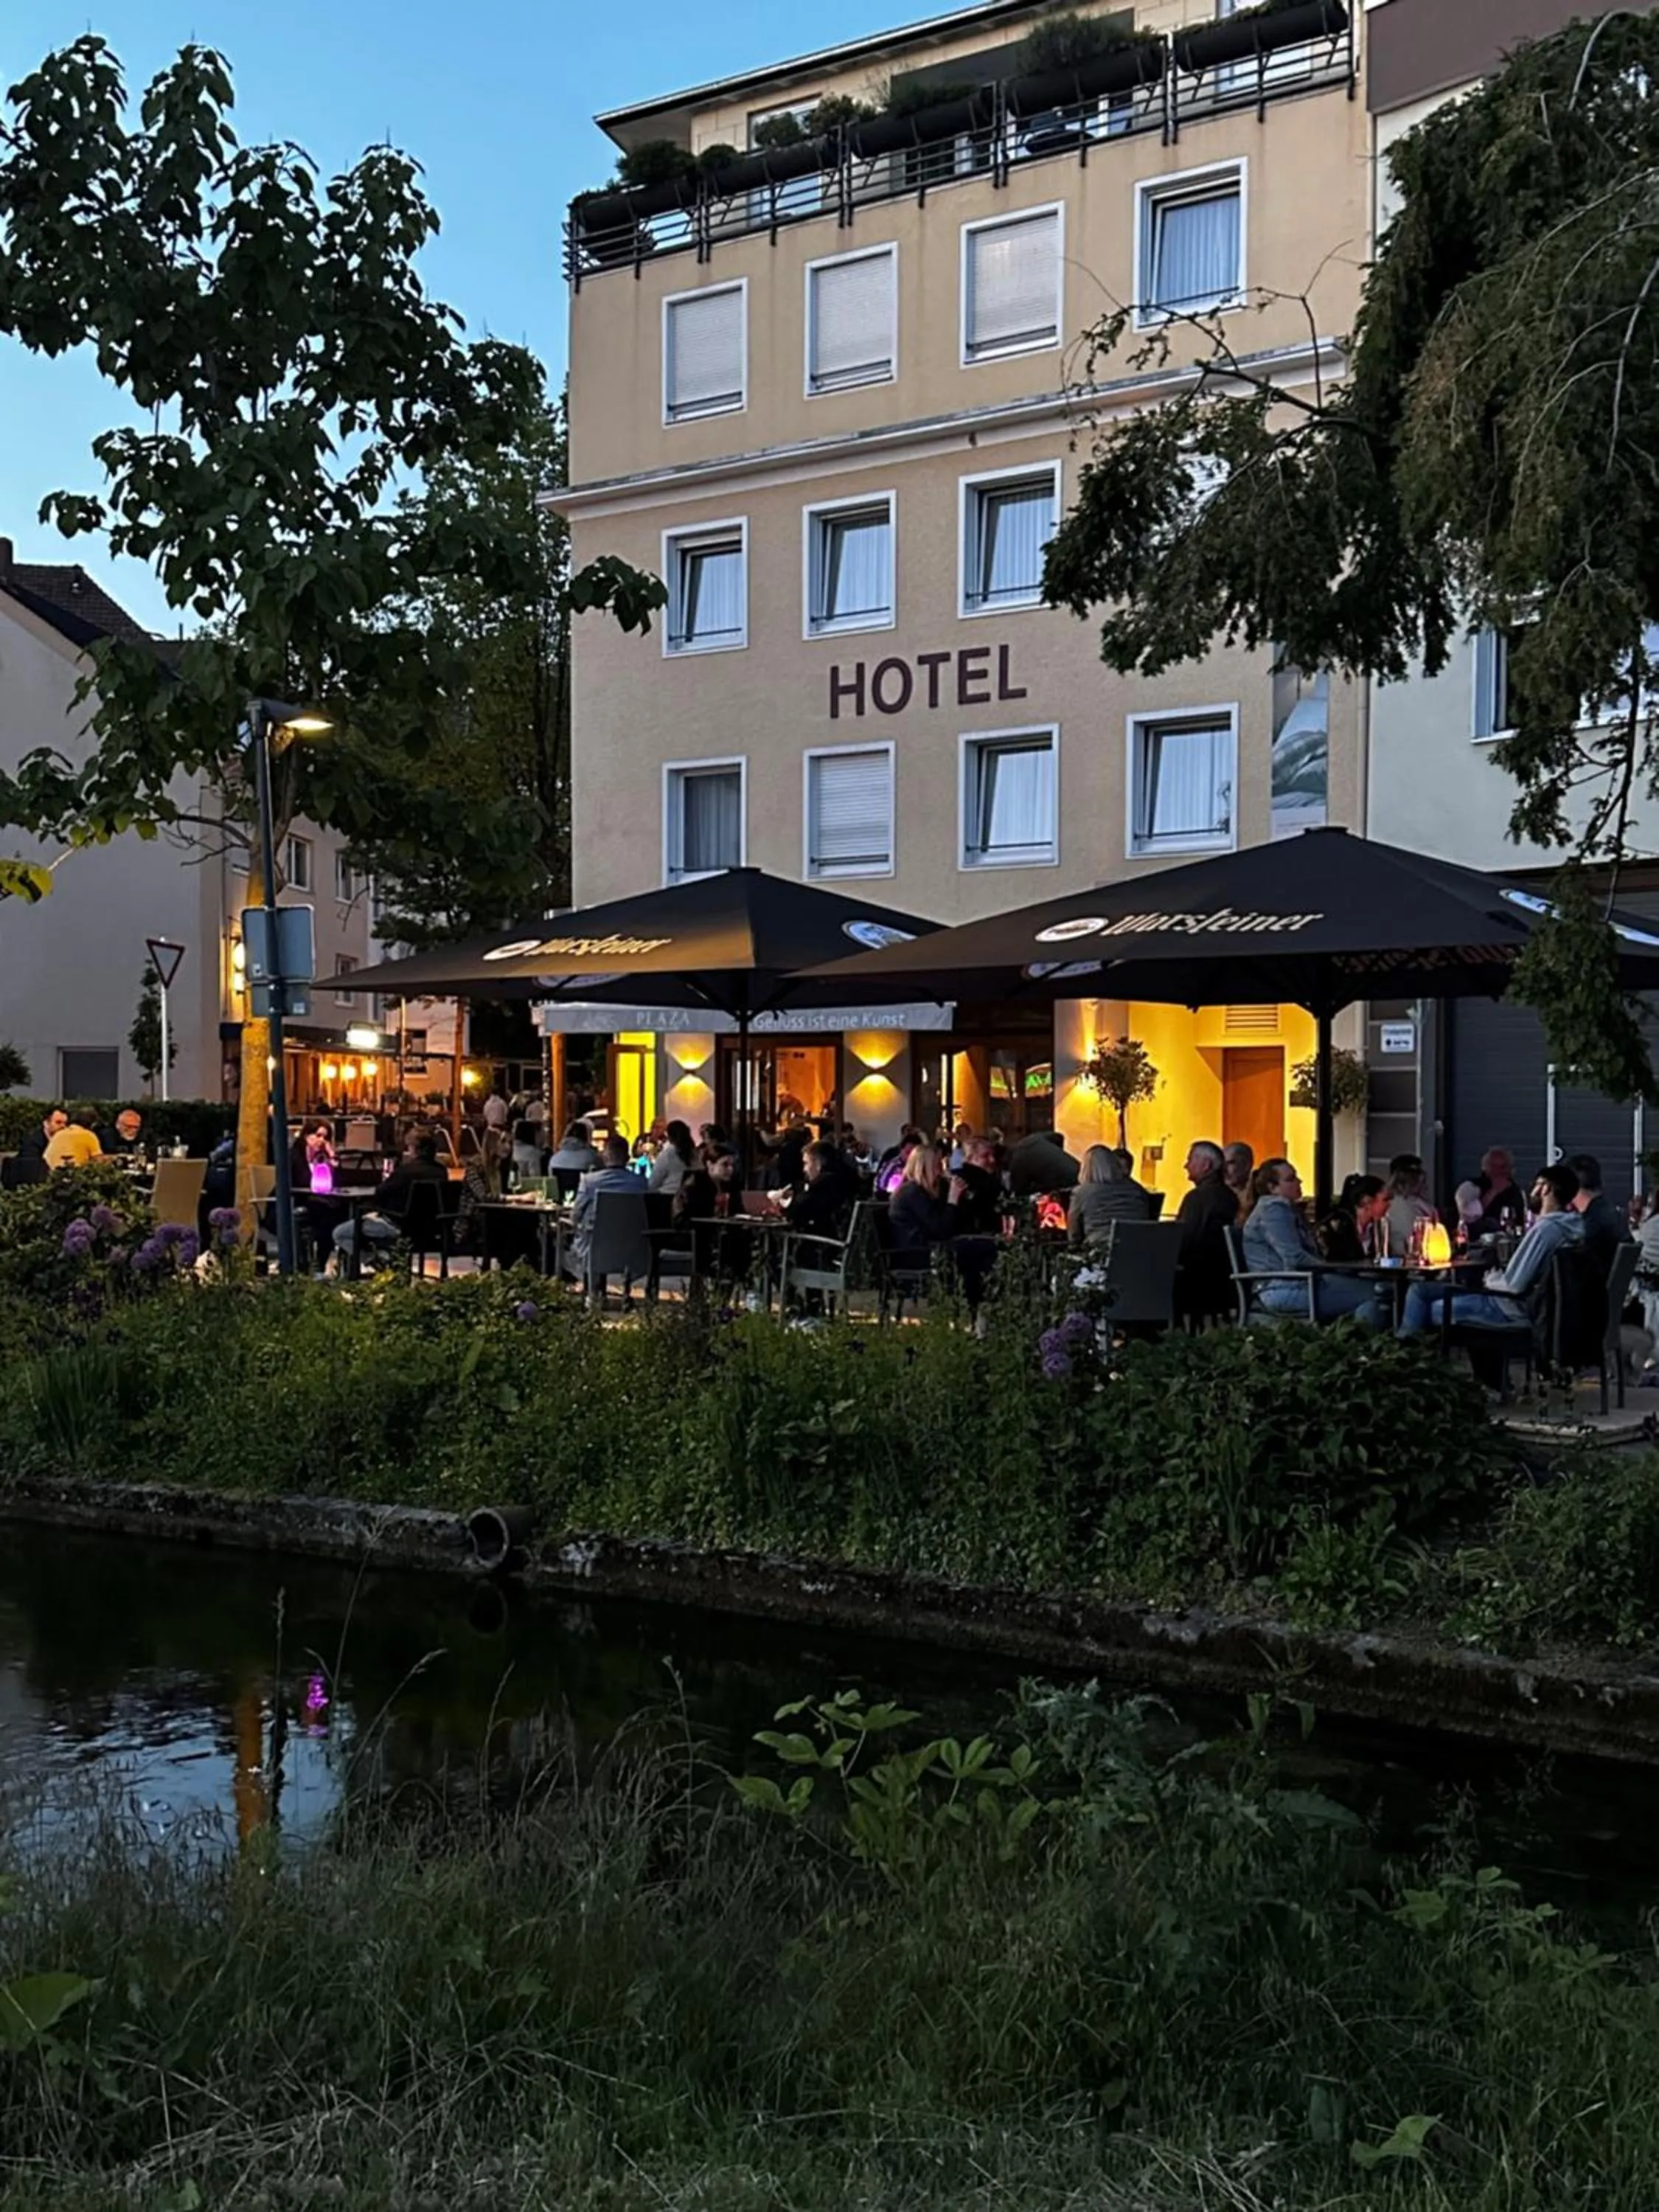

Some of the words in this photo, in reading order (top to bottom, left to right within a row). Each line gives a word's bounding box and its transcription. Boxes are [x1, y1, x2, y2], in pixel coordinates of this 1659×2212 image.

[830, 644, 1027, 719] HOTEL
[1099, 908, 1325, 936] Warsteiner
[636, 1011, 690, 1026] PLAZA
[808, 1015, 824, 1028] ist
[827, 1014, 858, 1028] eine
[862, 1012, 905, 1028] Kunst
